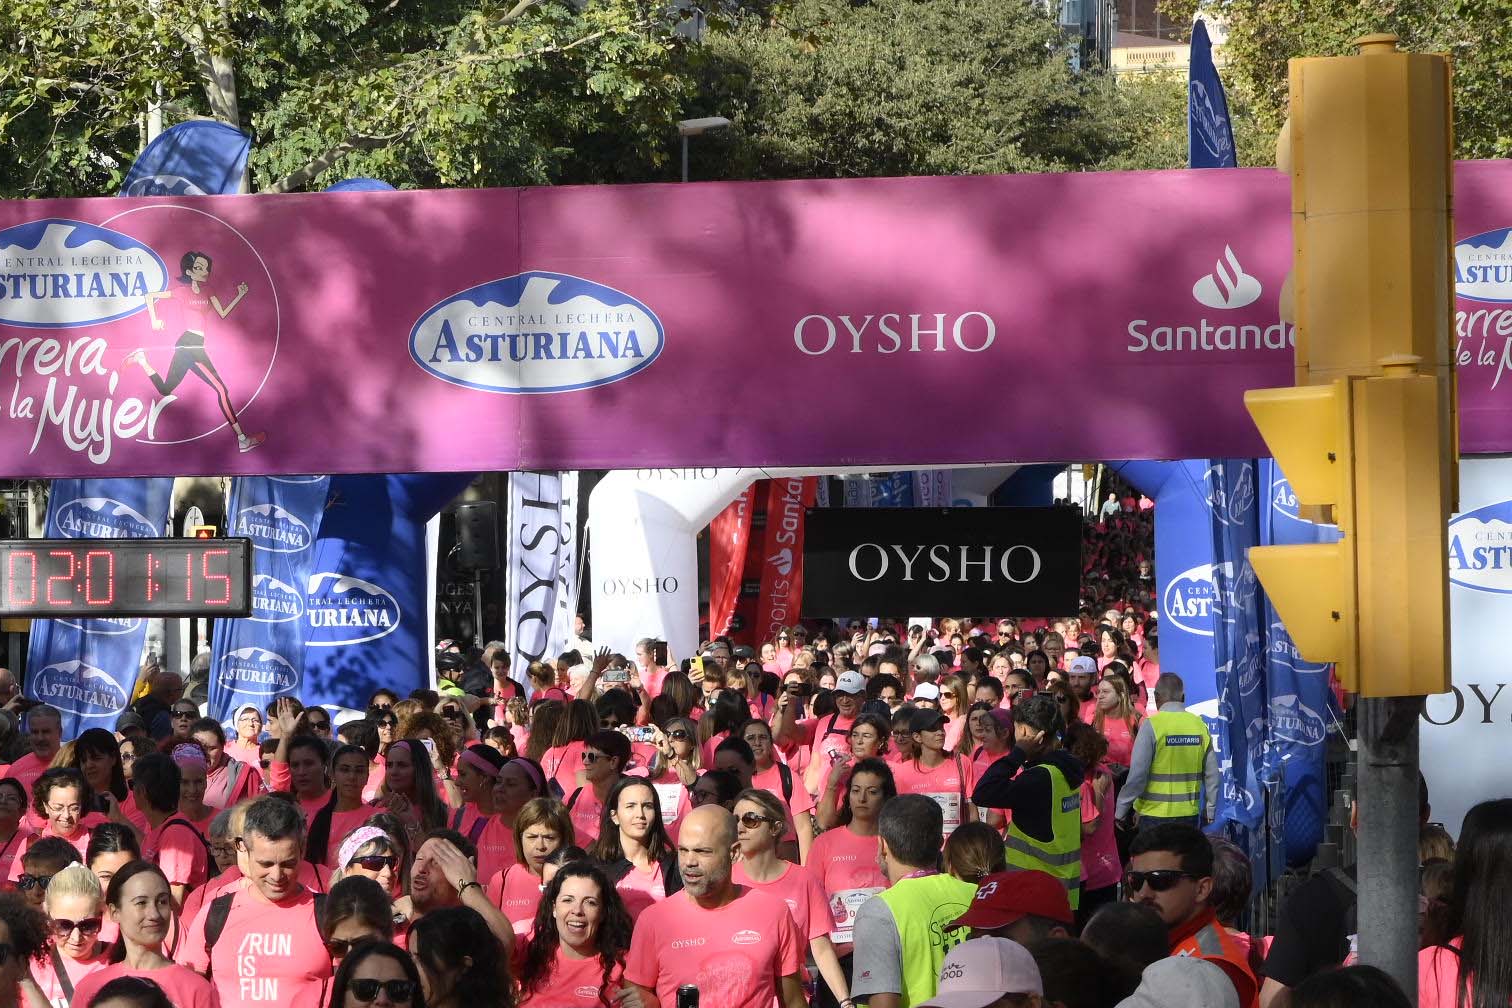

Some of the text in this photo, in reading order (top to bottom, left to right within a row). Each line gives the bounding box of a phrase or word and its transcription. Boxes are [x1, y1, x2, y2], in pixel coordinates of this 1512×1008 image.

[72, 254, 144, 267] LECHERA
[468, 311, 636, 327] CENTRAL LECHERA
[428, 317, 645, 364] ASTURIANA
[793, 311, 997, 355] OYSHO
[1477, 337, 1496, 367] la
[9, 380, 34, 420] la
[28, 372, 179, 465] Mujer
[239, 514, 304, 547] ASTURIANA
[847, 542, 1042, 584] OYSHO
[7, 550, 232, 606] 02:01:15
[602, 576, 679, 596] OYSHO
[253, 596, 299, 615] URIANA
[337, 597, 386, 606] LECHERA
[219, 668, 290, 688] ASTURIANA
[38, 675, 119, 710] ASTURIANA
[237, 955, 256, 977] IS
[239, 978, 279, 1001] FUN
